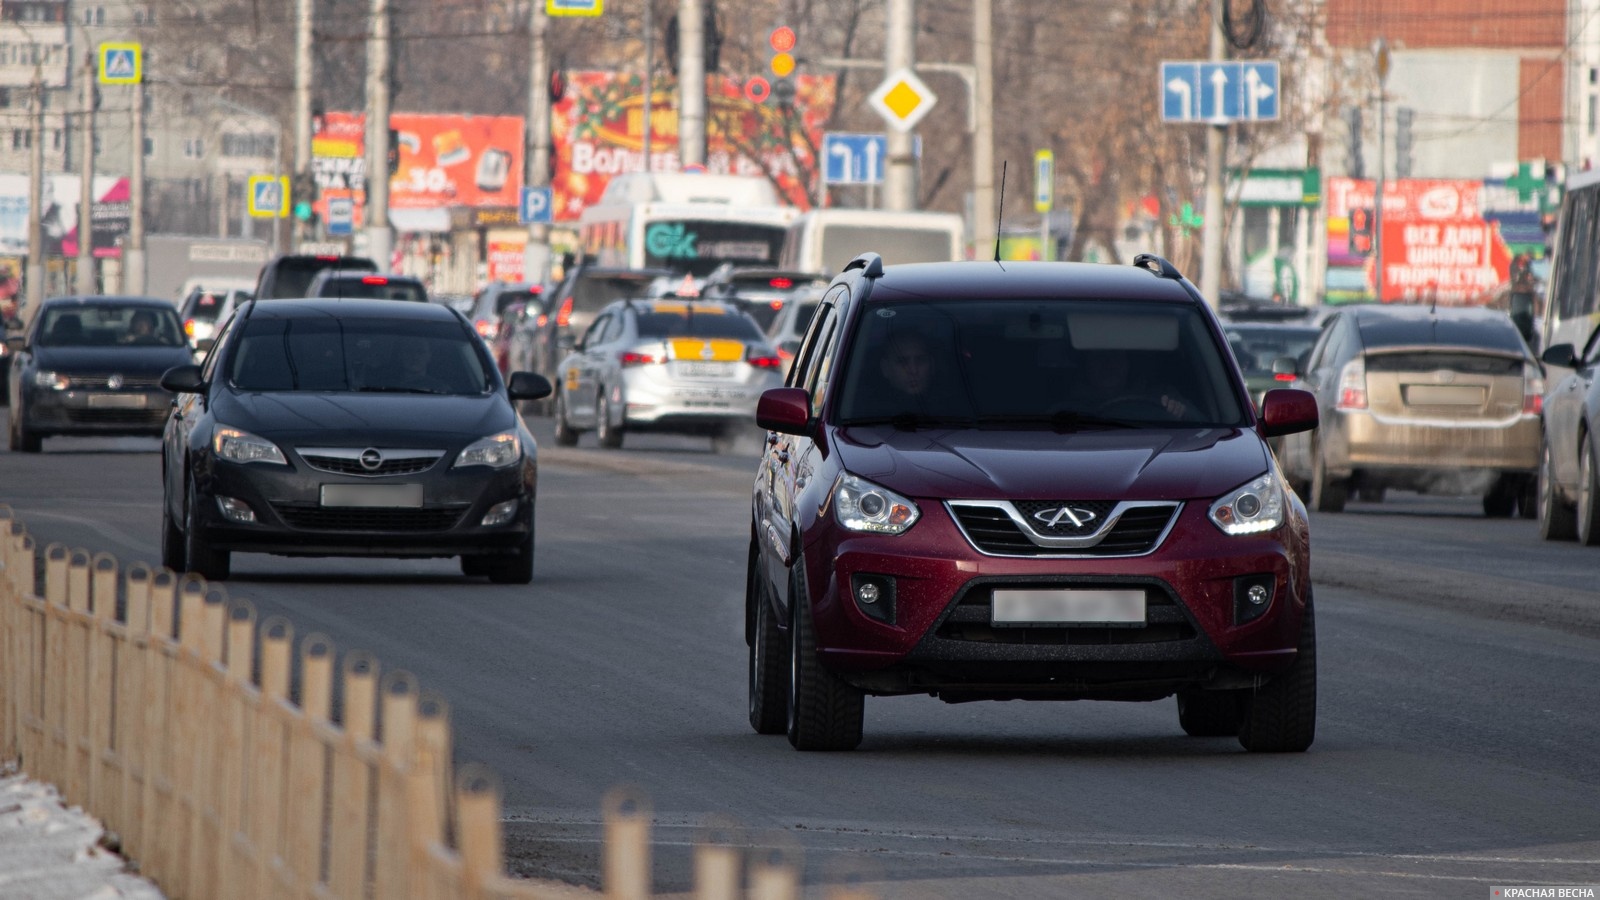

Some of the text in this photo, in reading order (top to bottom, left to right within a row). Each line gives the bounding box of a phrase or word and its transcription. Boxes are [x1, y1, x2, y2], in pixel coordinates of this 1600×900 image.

[527, 192, 546, 220] P
[1404, 225, 1483, 246] ВСЕ ДЛЯ
[1408, 247, 1478, 264] ШКОЛЫ
